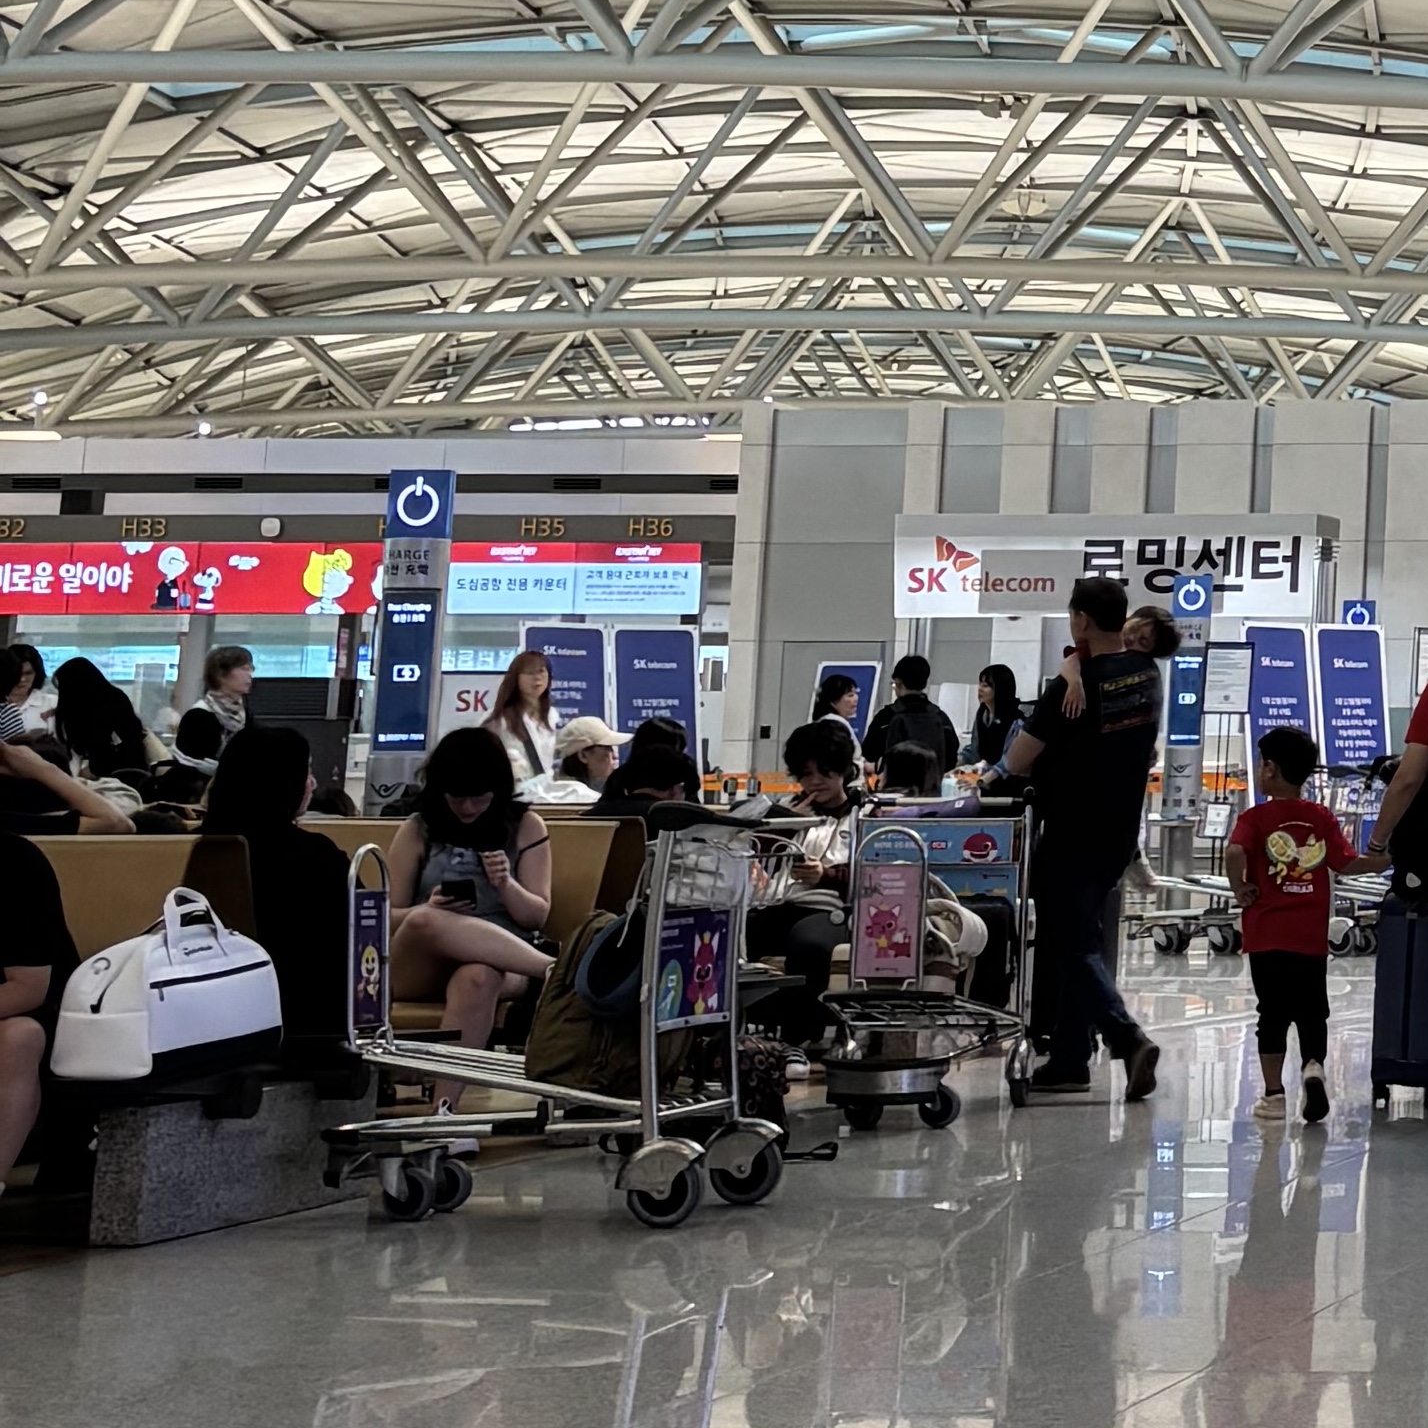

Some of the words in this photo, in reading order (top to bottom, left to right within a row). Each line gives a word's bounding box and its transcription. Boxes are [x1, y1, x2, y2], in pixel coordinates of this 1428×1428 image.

[121, 517, 167, 537] H33
[520, 517, 565, 537] H35
[629, 517, 673, 537] H36
[386, 549, 430, 560] HARGE
[1075, 535, 1301, 594] 로밍센터
[59, 561, 133, 593] 일이야
[456, 577, 502, 591] 도심공항
[507, 577, 528, 591] 전용
[532, 577, 568, 591] 카운터
[907, 568, 947, 593] SK
[961, 571, 1055, 592] telecom
[543, 645, 557, 655] SK
[633, 659, 647, 669] SK
[1261, 656, 1272, 666] SK
[1333, 658, 1344, 668] SK
[455, 689, 489, 712] SK
